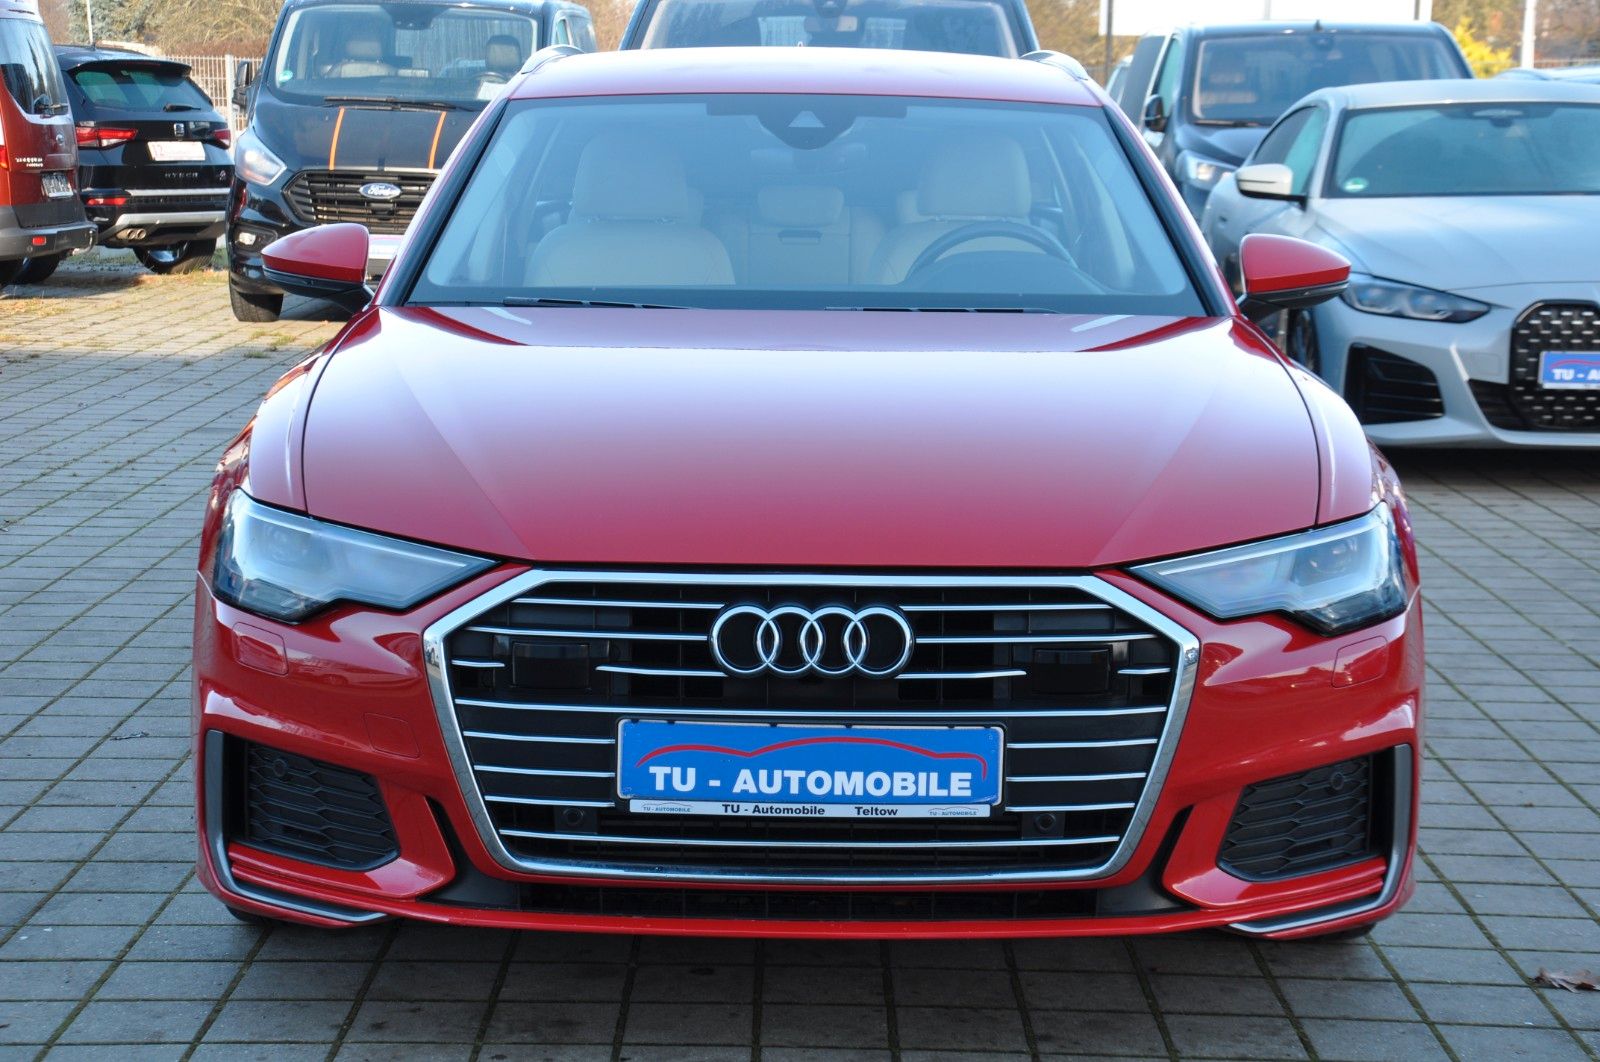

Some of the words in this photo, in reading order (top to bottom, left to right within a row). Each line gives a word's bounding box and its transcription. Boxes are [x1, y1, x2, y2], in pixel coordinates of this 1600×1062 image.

[1552, 368, 1575, 381] TU
[649, 766, 696, 792] TU
[709, 779, 721, 787] -
[732, 769, 972, 797] AUTOMOBILE
[722, 804, 740, 814] TU
[752, 804, 826, 816] Automobile
[854, 806, 899, 816] Teltow
